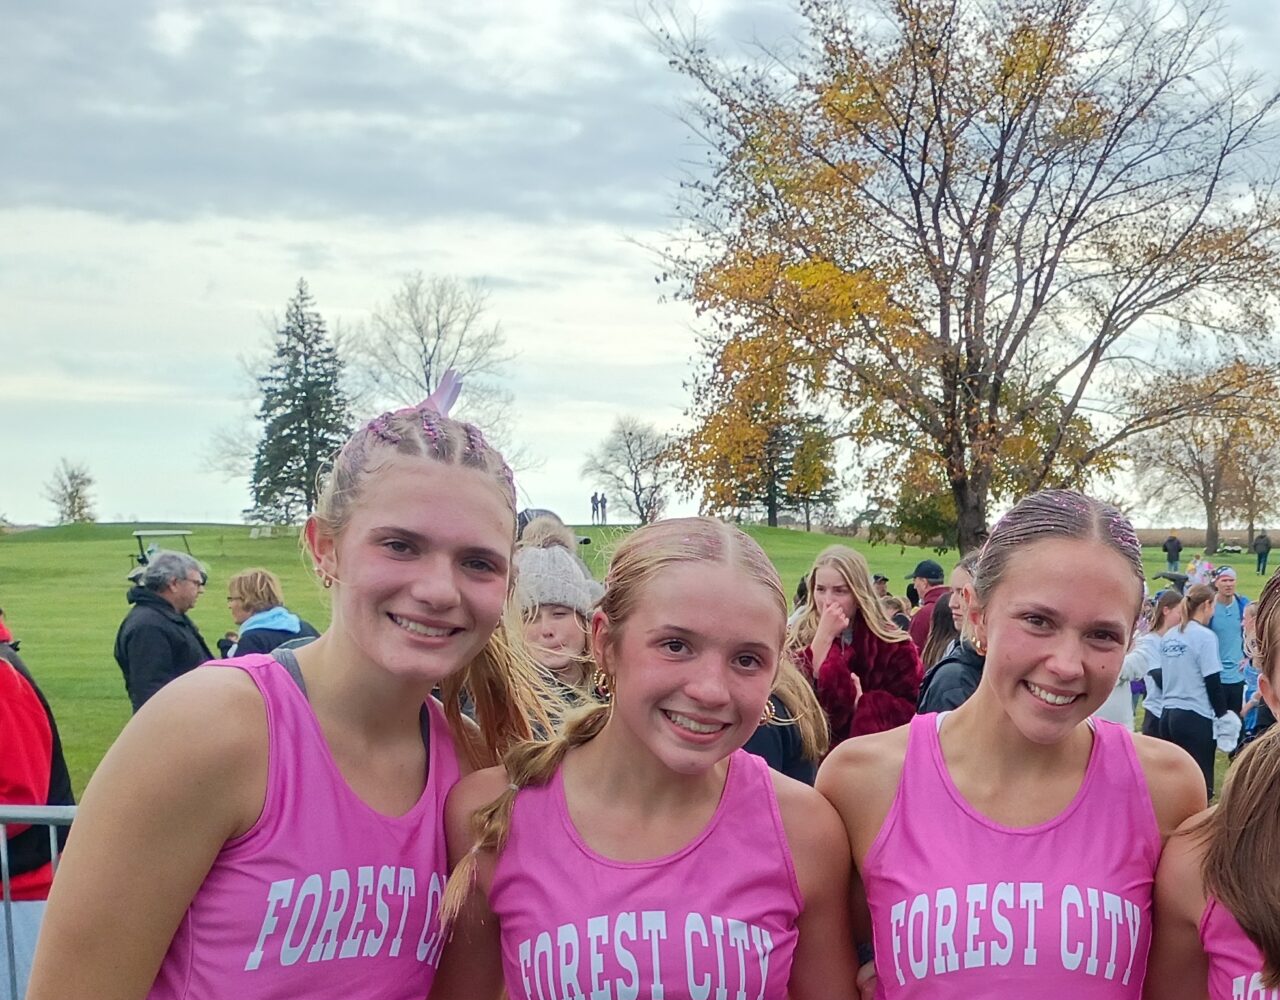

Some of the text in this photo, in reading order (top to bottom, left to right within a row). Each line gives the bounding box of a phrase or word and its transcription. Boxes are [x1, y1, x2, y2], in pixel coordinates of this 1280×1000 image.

[244, 865, 415, 971] FOREST
[890, 881, 1140, 986] FOREST CITY
